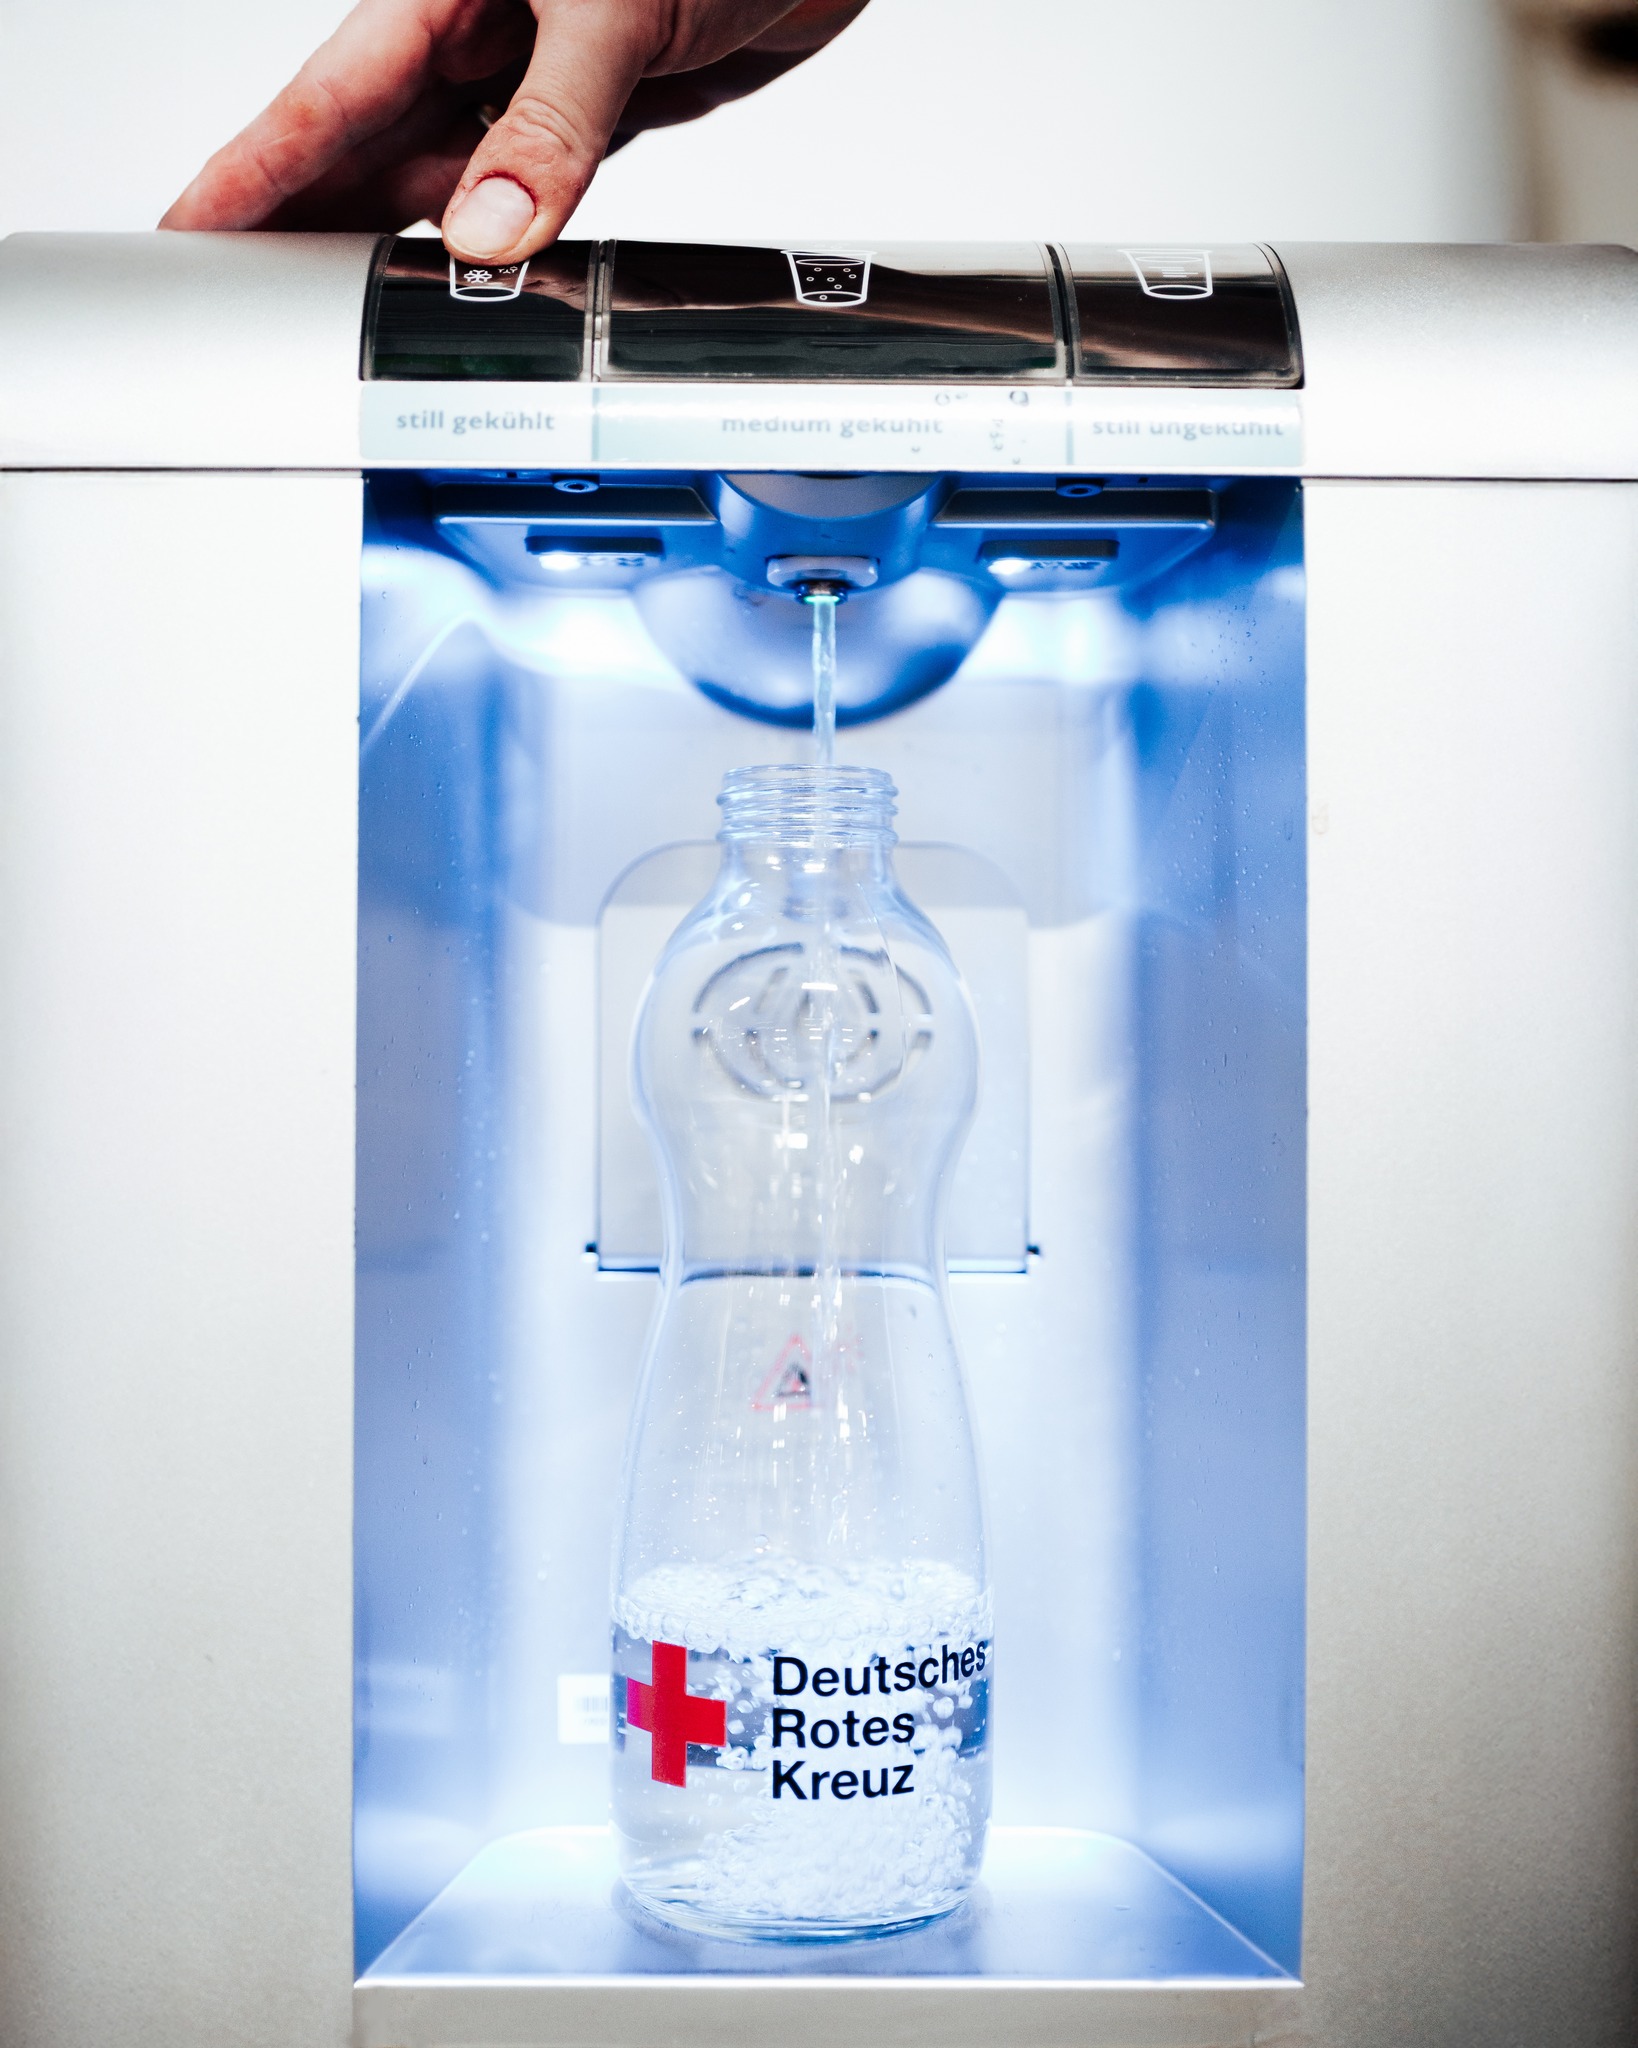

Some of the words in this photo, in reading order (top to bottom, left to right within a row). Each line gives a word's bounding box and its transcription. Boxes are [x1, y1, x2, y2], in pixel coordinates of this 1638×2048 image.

[396, 409, 445, 429] still
[451, 409, 556, 436] gekühlt
[721, 416, 832, 434] medium
[1091, 420, 1141, 436] still
[772, 1640, 987, 1698] Deutsches
[772, 1707, 916, 1749] Rotes
[772, 1759, 915, 1800] Kreuz
